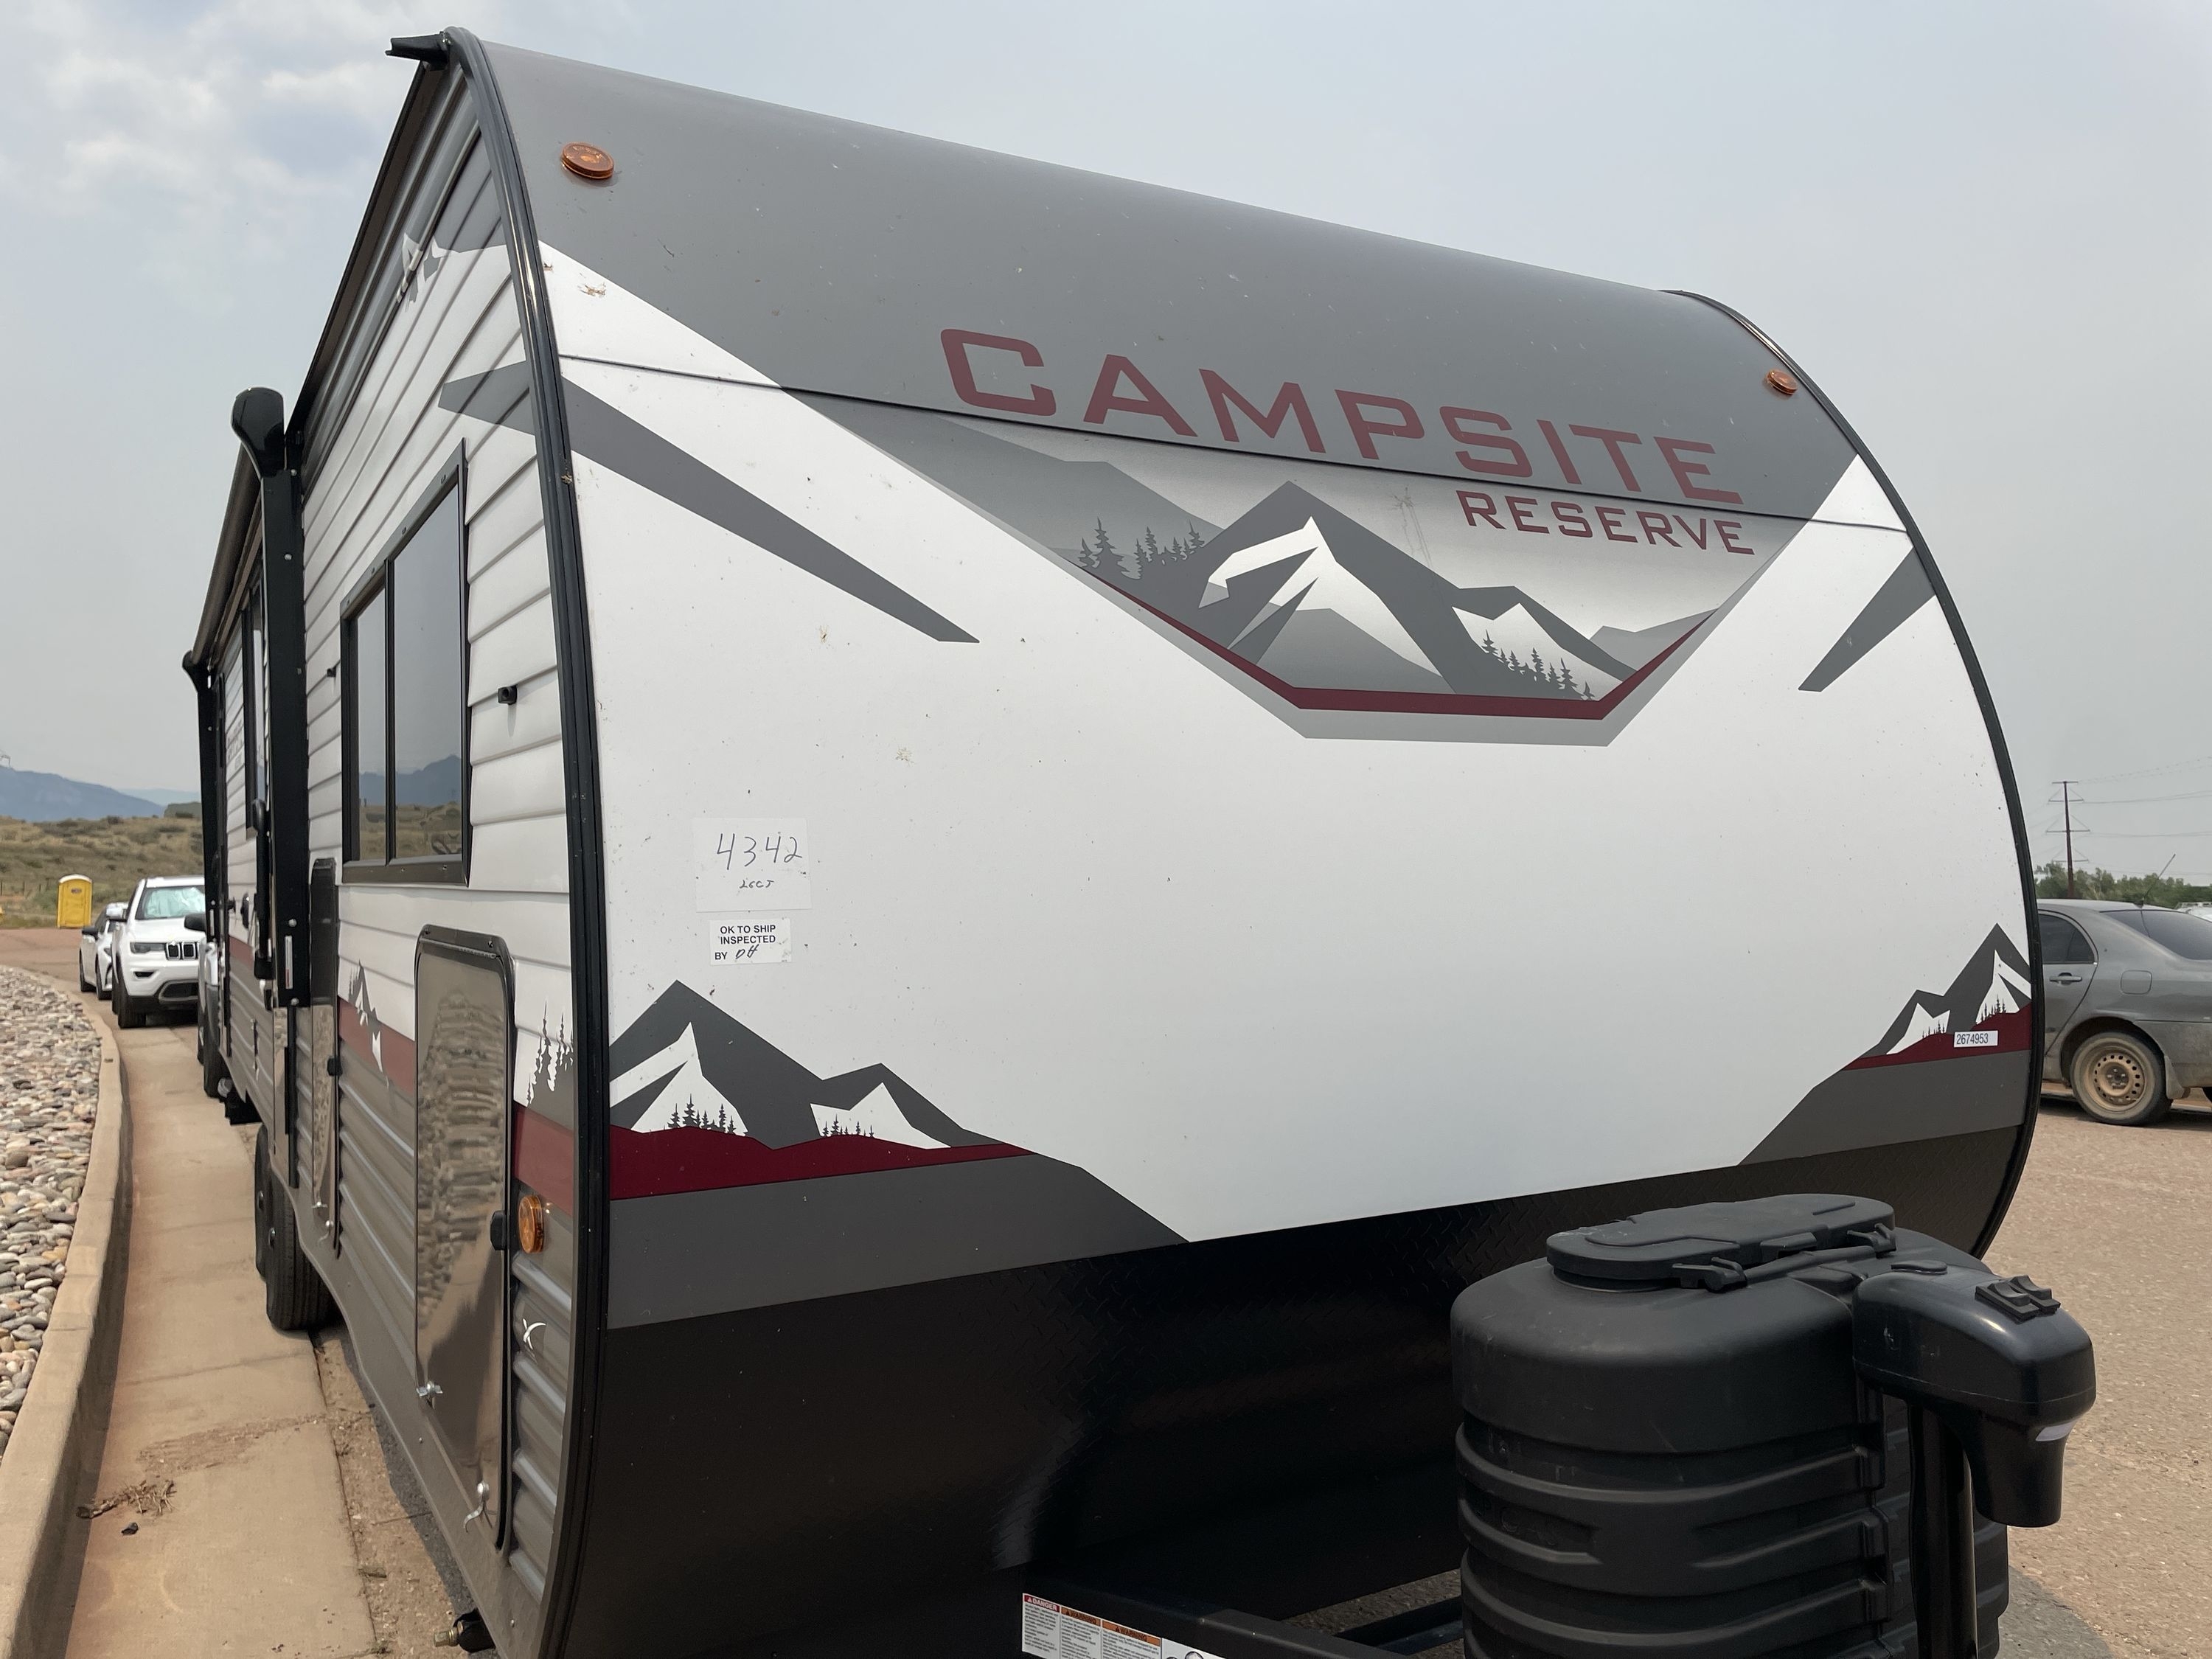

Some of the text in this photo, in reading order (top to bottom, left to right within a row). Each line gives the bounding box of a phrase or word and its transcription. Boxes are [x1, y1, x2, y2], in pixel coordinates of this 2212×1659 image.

[940, 329, 1743, 504] CAMPSITE
[1458, 490, 1755, 555] RESERVE
[717, 832, 803, 870] 4342
[720, 924, 776, 934] OK TO SHIP
[720, 935, 776, 945] INSPECTED
[714, 951, 728, 960] BY
[1956, 1032, 1989, 1045] 2674953
[1032, 1598, 1057, 1612] DANGER
[1070, 1610, 1097, 1625] WARNING
[1120, 1627, 1147, 1641] WARNING
